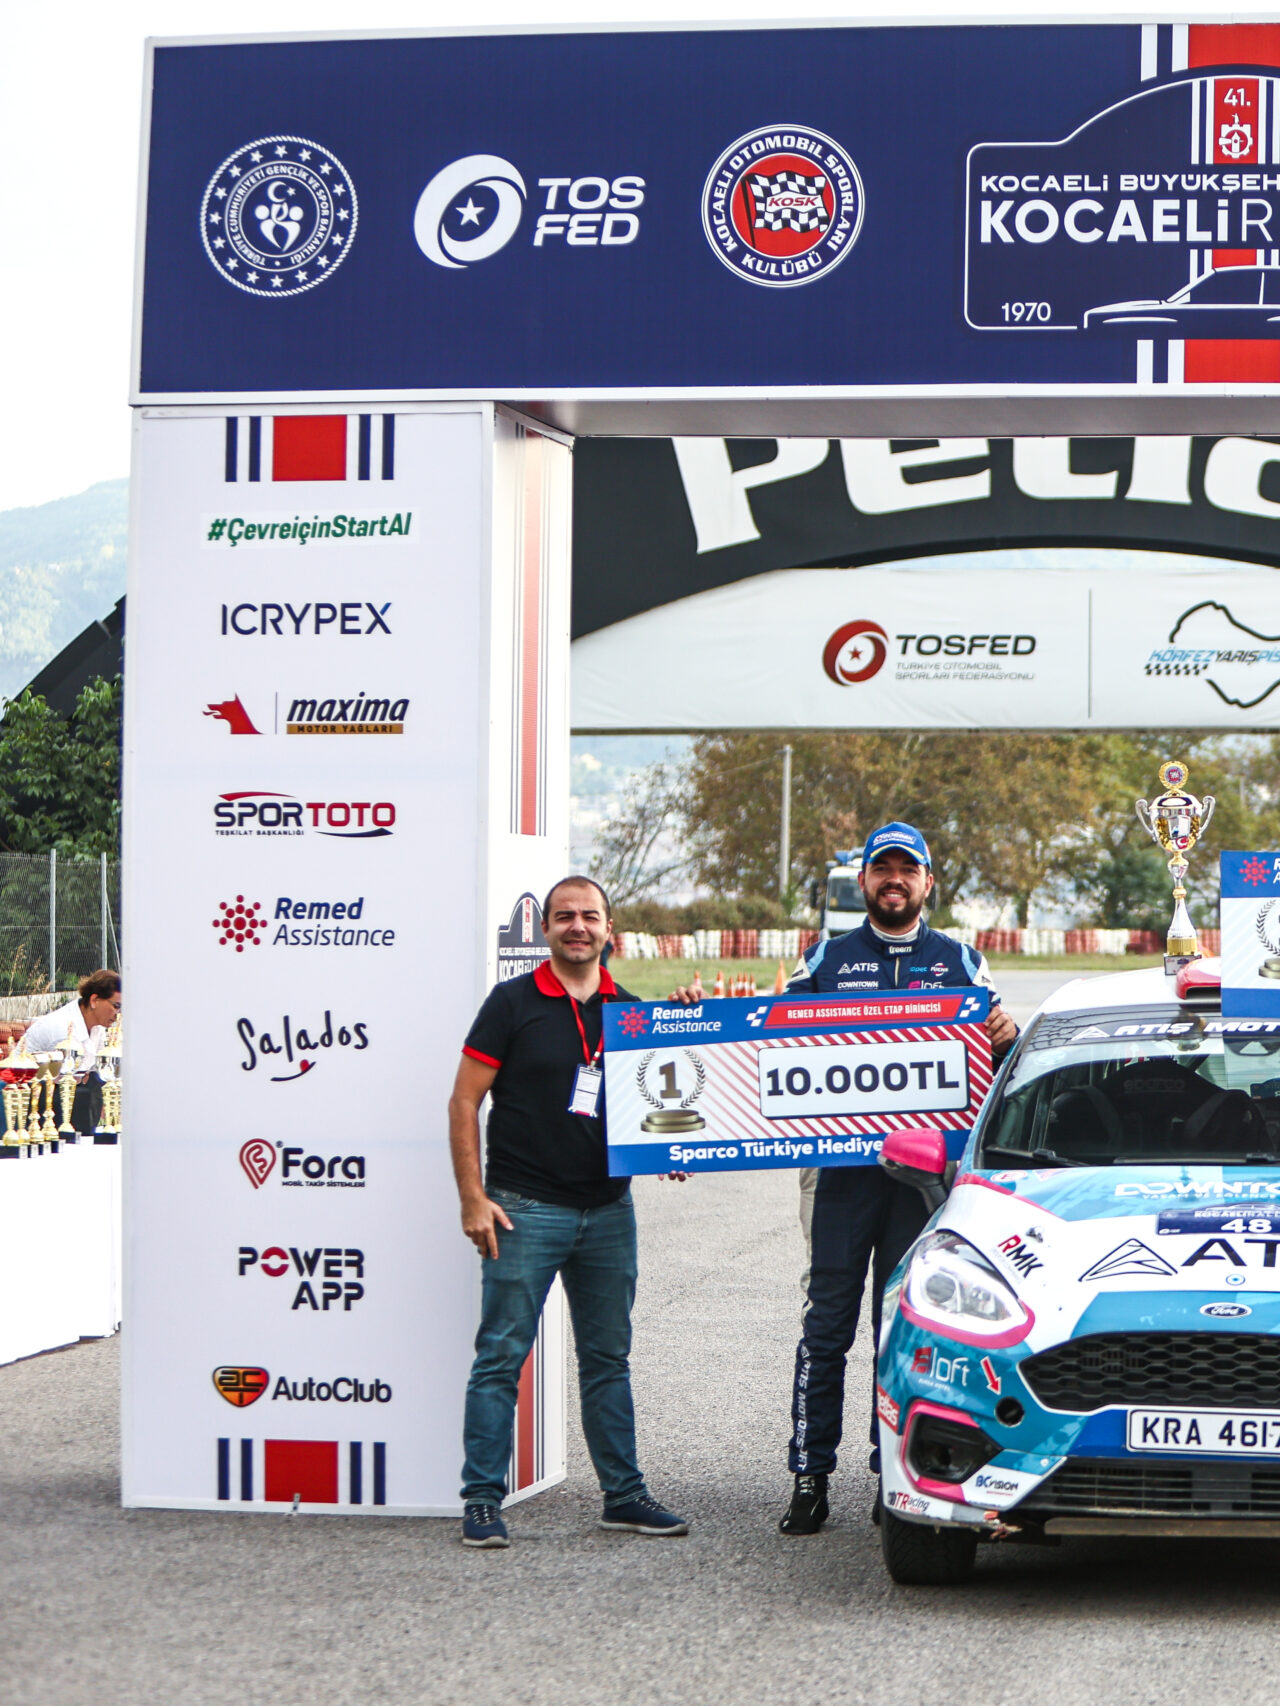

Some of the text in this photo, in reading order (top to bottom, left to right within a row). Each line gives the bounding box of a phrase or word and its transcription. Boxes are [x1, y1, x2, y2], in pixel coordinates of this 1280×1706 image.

[1223, 88, 1251, 107] 41.
[266, 165, 309, 180] GENÇLİK
[308, 178, 321, 190] VE
[316, 189, 330, 216] SPOR
[537, 176, 645, 209] TOS
[767, 196, 819, 208] KOSK
[823, 153, 854, 251] SPORLARI
[533, 213, 639, 246] FED
[741, 250, 823, 276] KULÜBÜ
[1001, 302, 1051, 322] 1970
[221, 602, 392, 635] ICRYPEX
[895, 634, 1036, 656] TOSFED
[286, 691, 410, 722] maxima
[297, 723, 393, 733] MOTOR YAĞLARI
[274, 897, 364, 920] Remed
[272, 924, 396, 947] Assistance
[837, 981, 879, 989] DOWNTOWN
[652, 1005, 704, 1020] Remed
[787, 1002, 941, 1019] REMED ASSISTANCE ÖZEL ETAP BİRİNCİSİ
[651, 1020, 722, 1034] Assistance
[237, 1010, 369, 1071] Salados
[659, 1060, 683, 1099] 1
[766, 1060, 959, 1097] 10.000TL
[282, 1147, 366, 1180] Fora
[669, 1137, 883, 1164] Sparco Türkiye Hediye
[1220, 1218, 1272, 1234] 48
[238, 1246, 365, 1278] POWER
[997, 1234, 1044, 1278] RMK
[291, 1281, 365, 1311] APP
[1210, 1304, 1241, 1316] Ford
[272, 1376, 392, 1402] AutoClub
[1142, 1416, 1202, 1445] KRA
